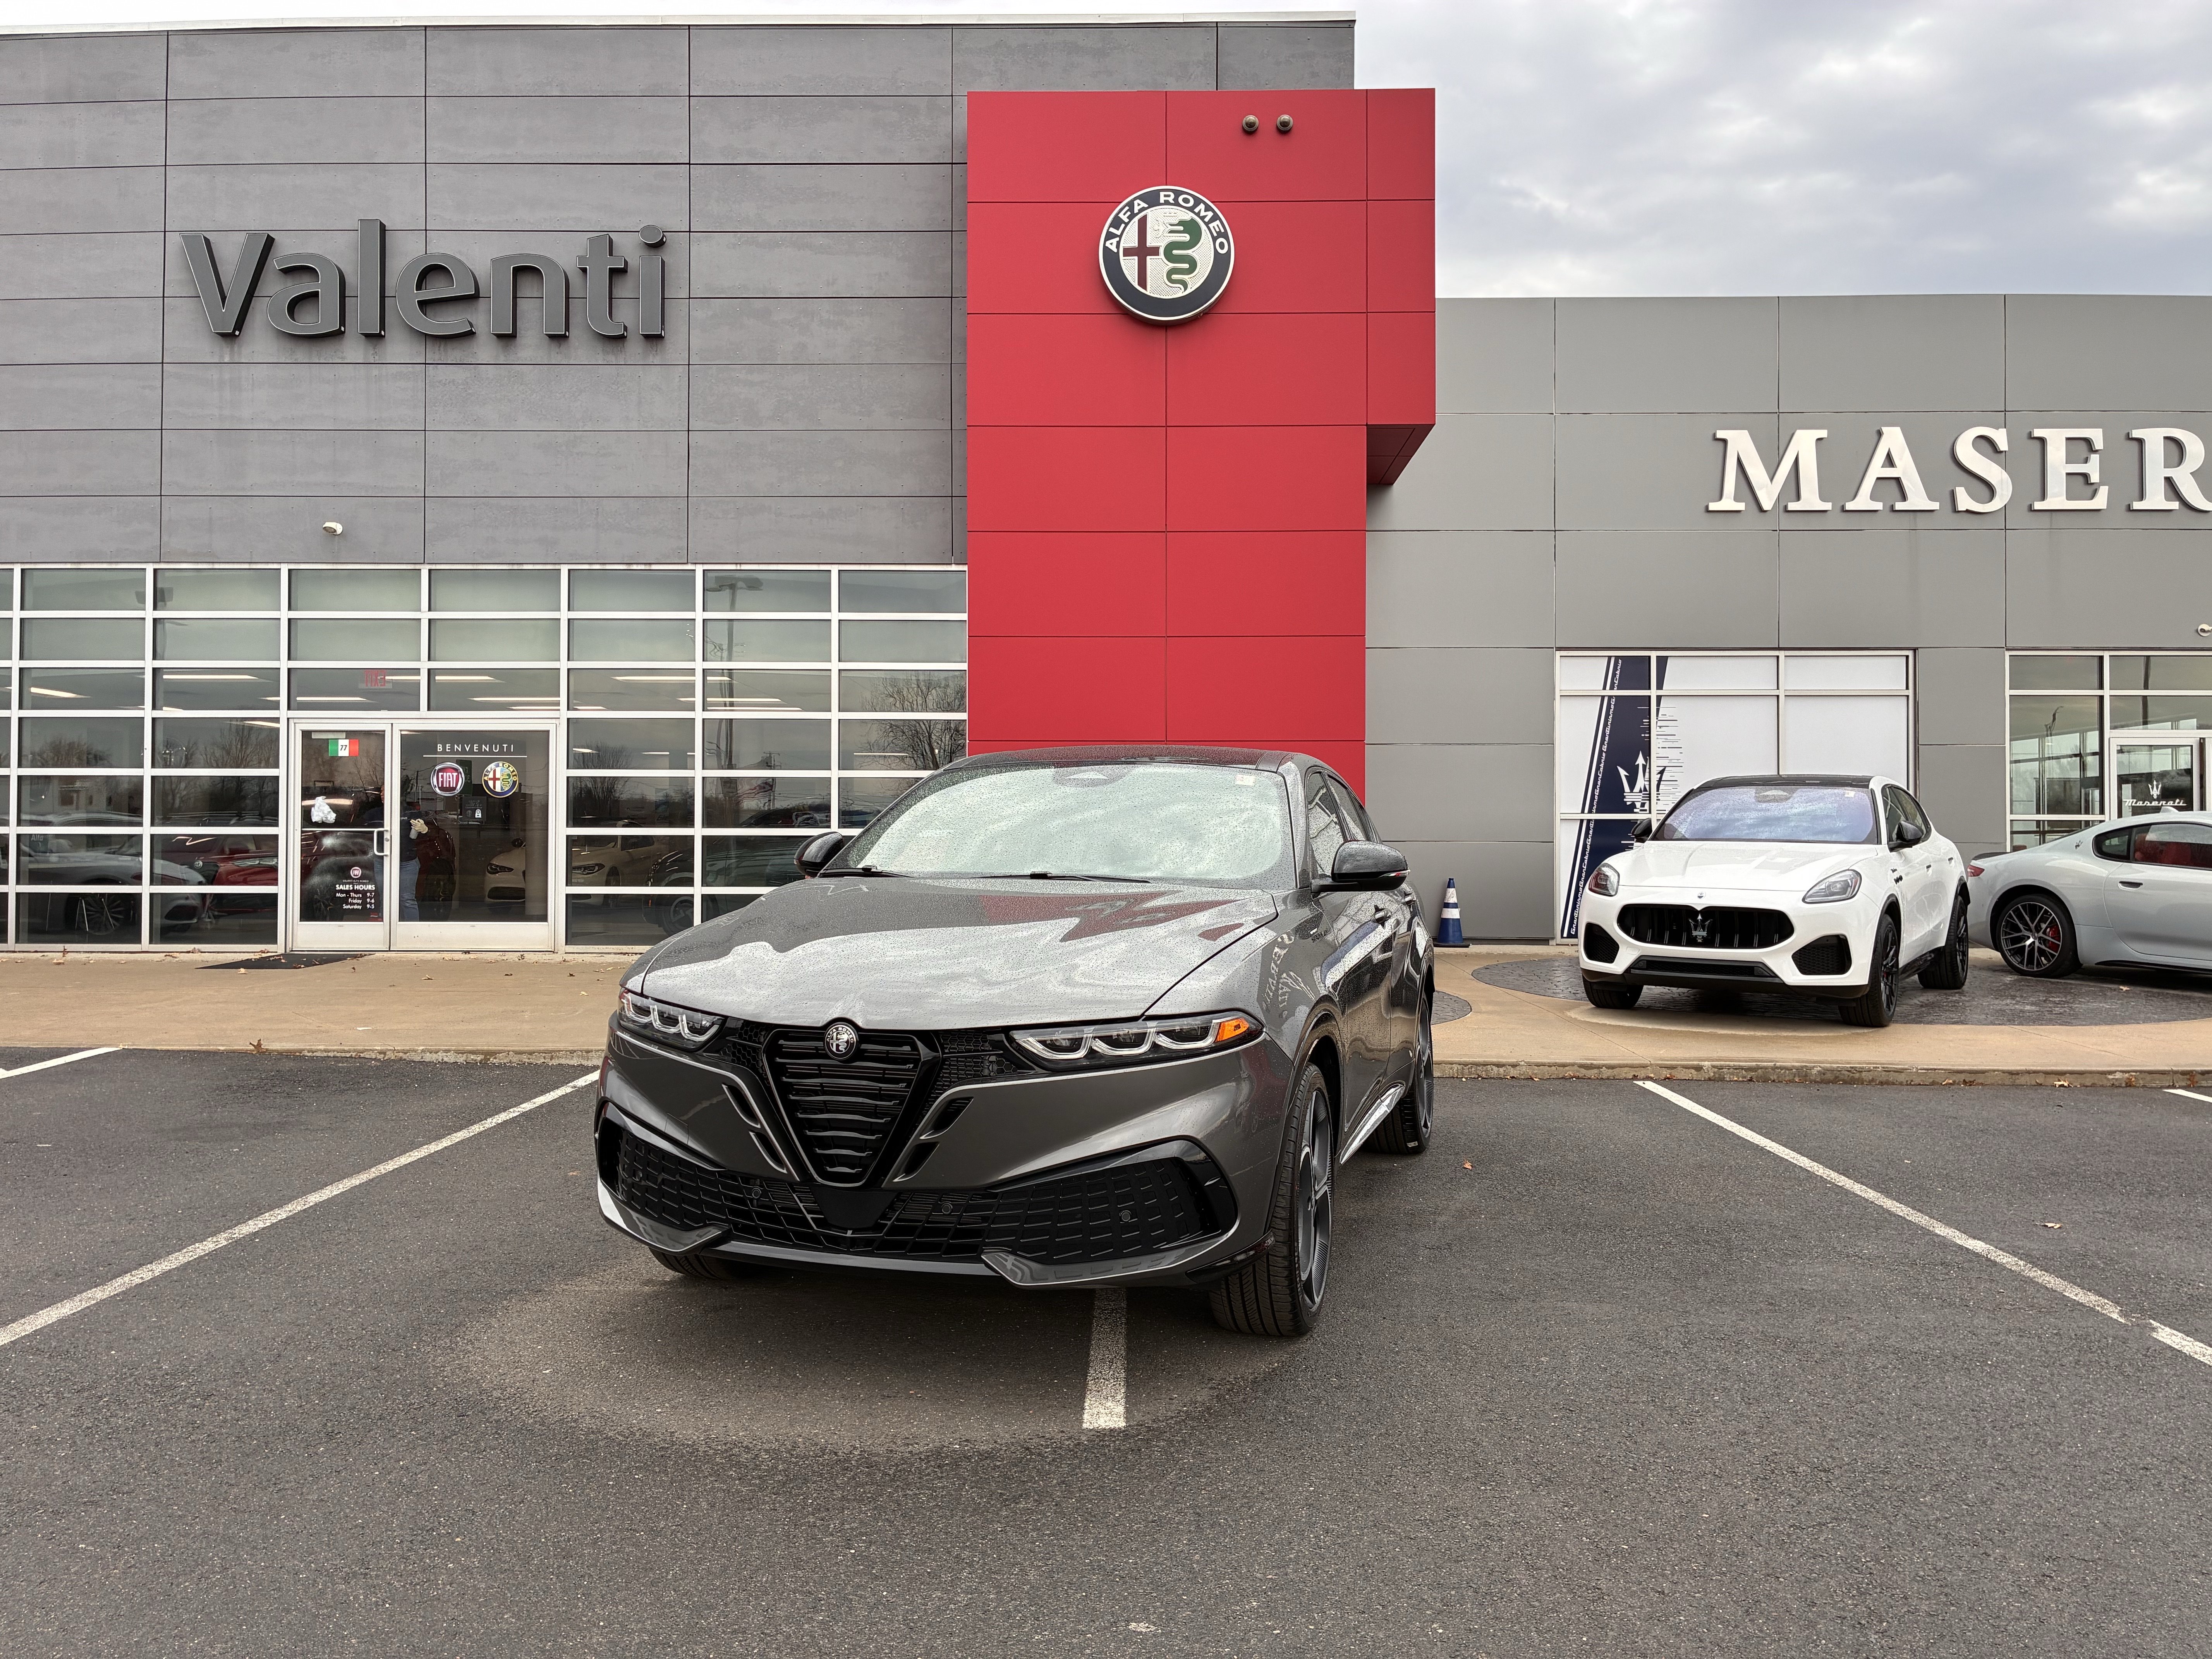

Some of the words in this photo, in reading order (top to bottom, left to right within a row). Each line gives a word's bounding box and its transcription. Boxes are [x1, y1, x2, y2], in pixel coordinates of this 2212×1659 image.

[1104, 199, 1149, 253] ALFA
[1159, 191, 1228, 254] ROMEO
[179, 219, 666, 338] Valenti
[1707, 426, 2212, 514] MASER
[437, 744, 514, 752] BENVENUTI
[439, 772, 458, 787] FIAT
[484, 764, 496, 781] ALFA
[499, 763, 517, 781] ROMEO
[826, 1029, 836, 1042] ALFA
[838, 1027, 854, 1043] ROMEO
